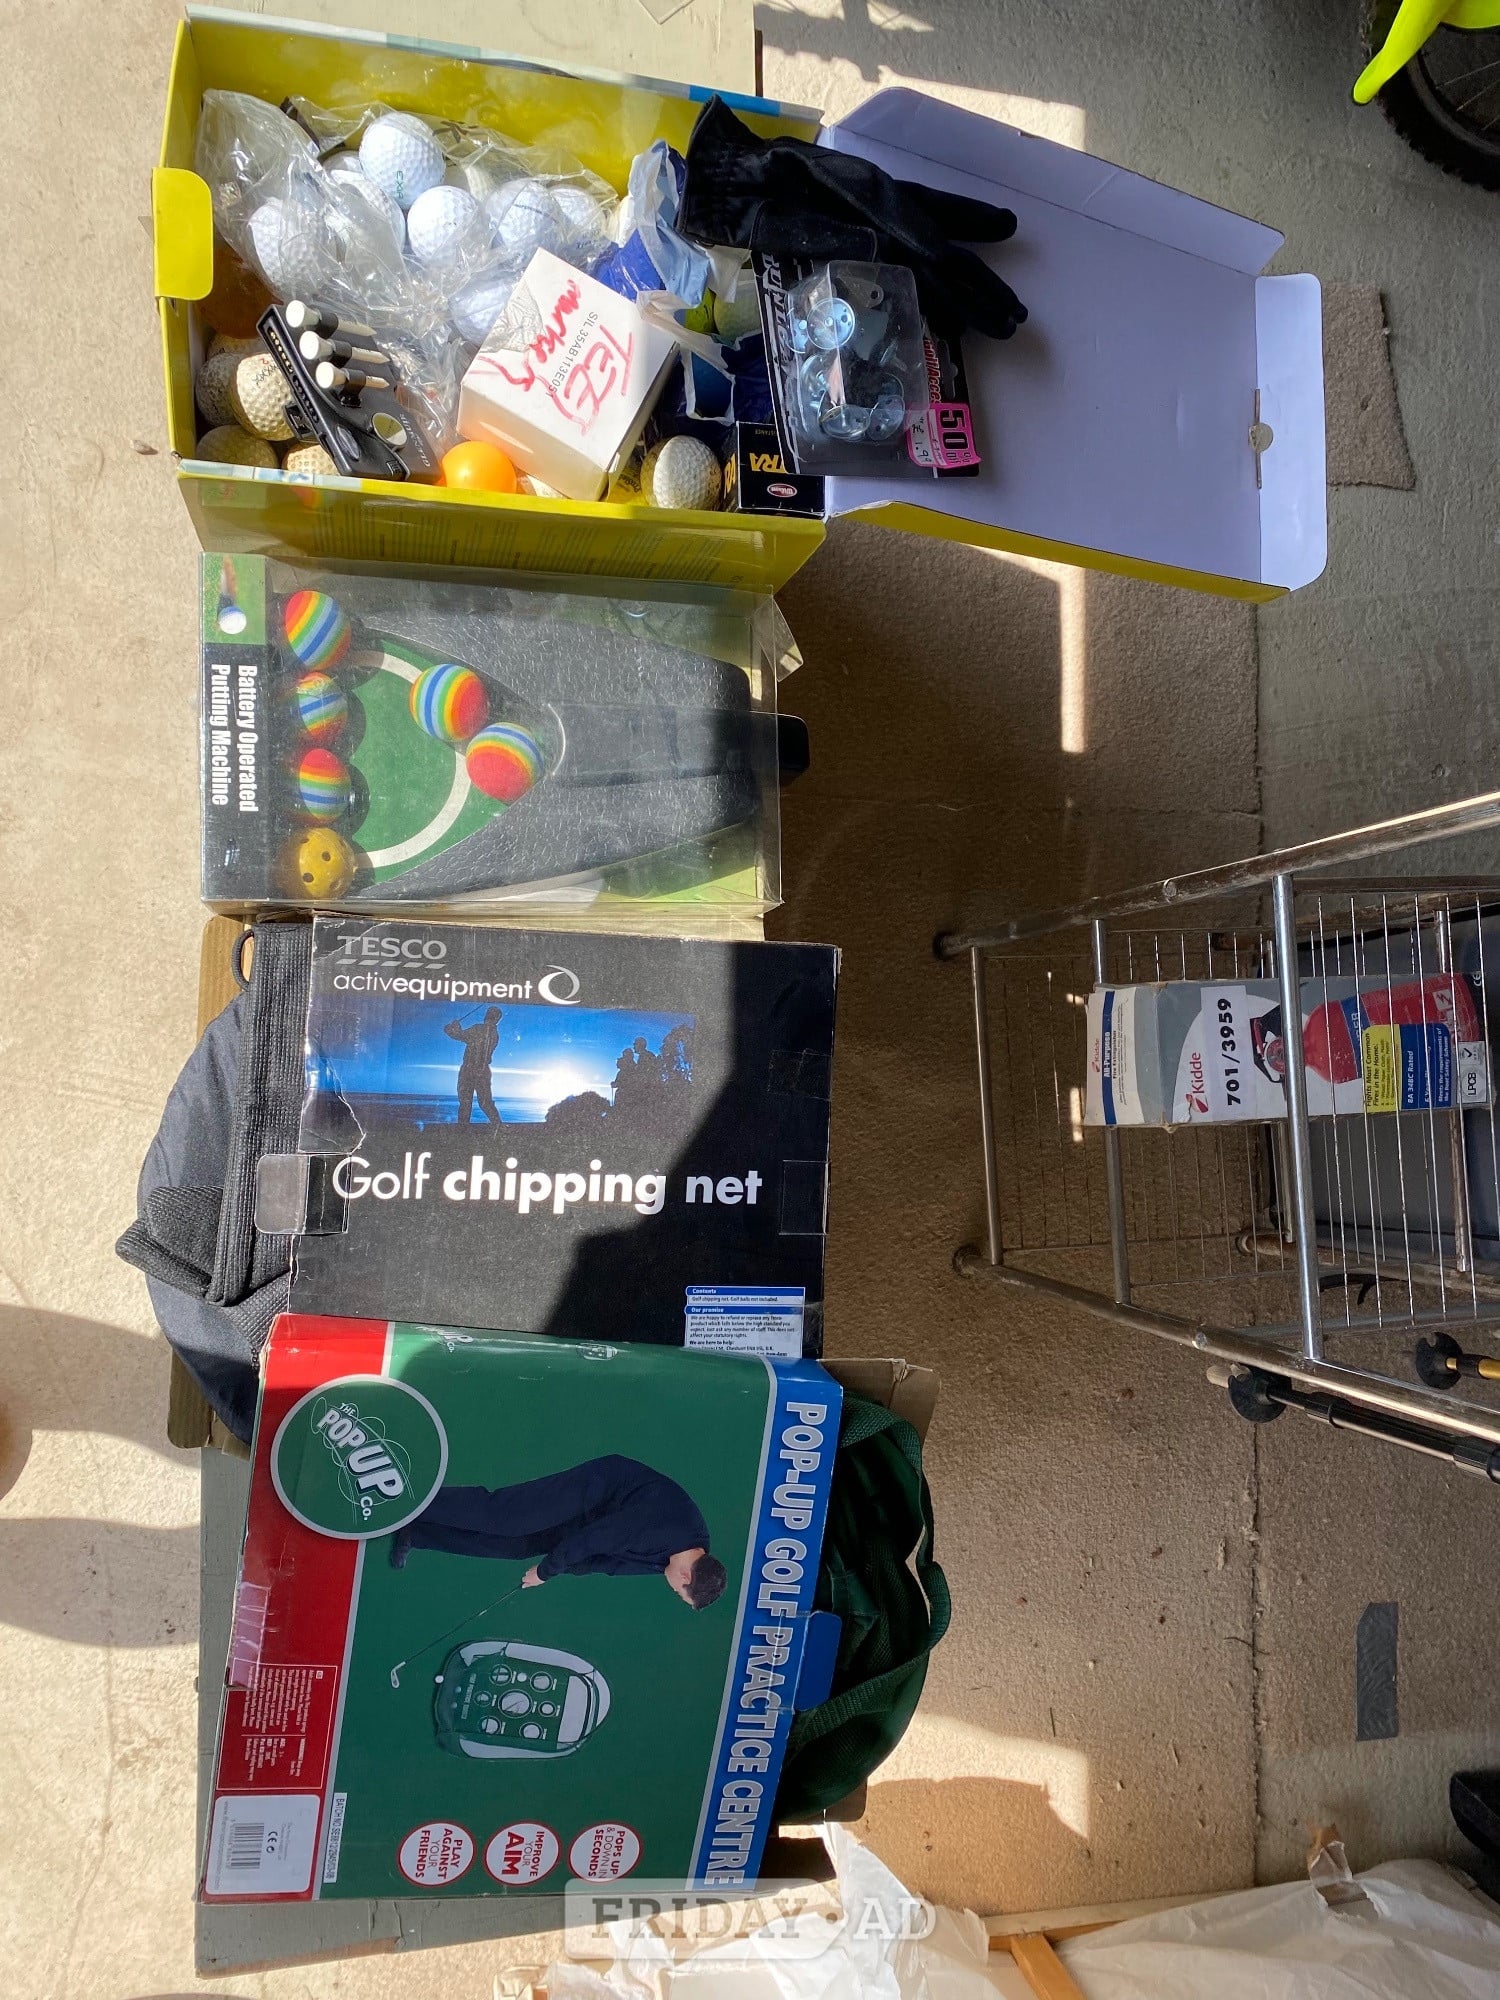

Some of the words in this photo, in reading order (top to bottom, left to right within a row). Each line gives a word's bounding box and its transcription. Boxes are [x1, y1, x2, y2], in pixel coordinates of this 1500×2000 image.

[587, 311, 599, 328] SIL
[940, 409, 969, 450] 50
[211, 664, 231, 727] Putting
[237, 665, 258, 729] Battery
[211, 730, 232, 806] Machine
[237, 731, 259, 812] Operated
[337, 936, 447, 960] TESCO
[333, 971, 533, 1002] activequipment
[1103, 1032, 1111, 1078] All-Purpose
[1189, 1052, 1205, 1093] Kidde
[1217, 998, 1241, 1105] 701/3959
[1467, 1073, 1476, 1096] LPCB
[333, 1152, 431, 1199] Golf
[443, 1156, 666, 1214] chipping
[686, 1170, 763, 1204] net
[339, 1402, 355, 1416] THE
[316, 1408, 369, 1449] POP
[348, 1444, 405, 1499] UP
[771, 1401, 828, 1530] POP-UP
[360, 1496, 373, 1521] Co.
[756, 1537, 808, 1616] GOLF
[727, 1625, 794, 1774] PRACTICE
[333, 1798, 345, 1818] BATCH
[416, 1830, 431, 1878] FRIENDS
[427, 1840, 441, 1868] YOUR
[437, 1828, 453, 1879] AGAINST
[450, 1839, 463, 1868] PLAY
[501, 1831, 525, 1876] AIM
[523, 1842, 534, 1867] YOUR
[529, 1831, 546, 1877] IMPROVE
[588, 1829, 605, 1877] SECONDS
[602, 1836, 614, 1868] DOWN
[612, 1830, 626, 1860] POPS
[704, 1778, 765, 1887] CENTRE
[598, 1869, 607, 1879] IN
[610, 1860, 621, 1875] UP
